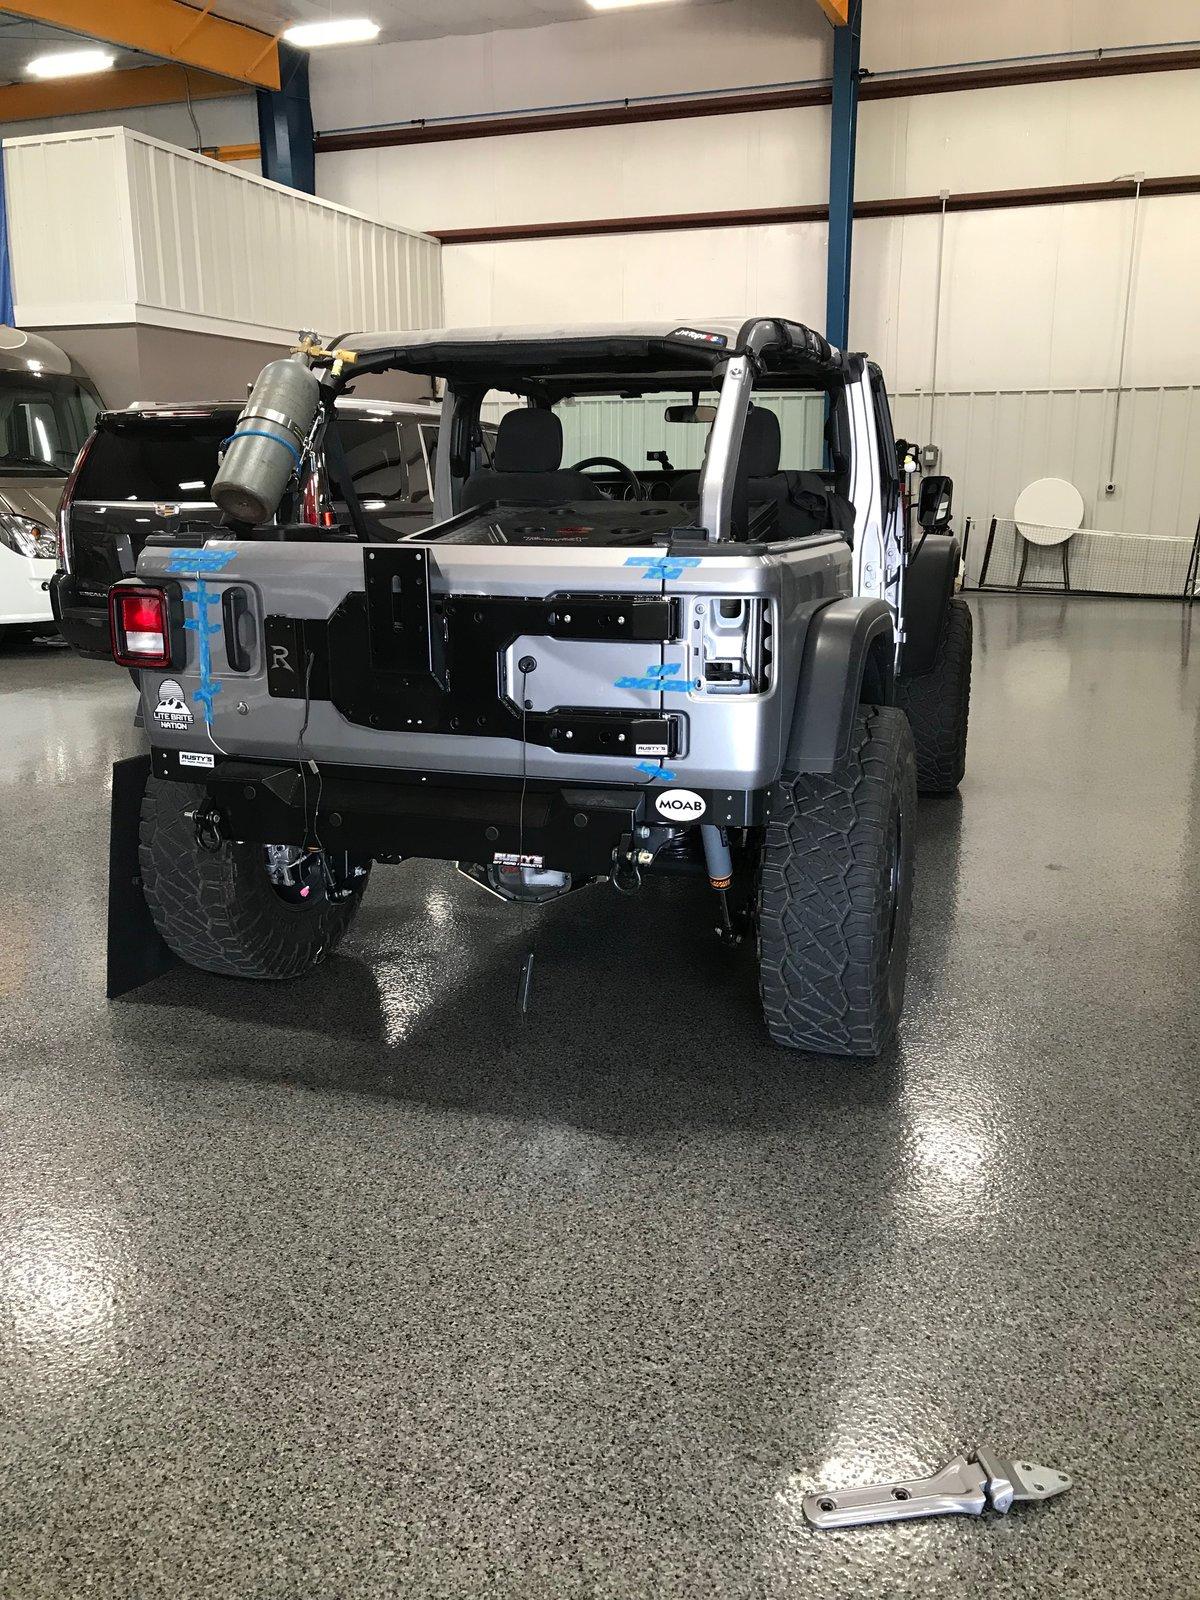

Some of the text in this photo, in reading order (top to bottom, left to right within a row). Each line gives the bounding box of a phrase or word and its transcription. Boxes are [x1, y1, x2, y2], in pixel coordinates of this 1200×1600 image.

[270, 645, 294, 672] R
[153, 711, 194, 722] LITE BRITE
[160, 721, 188, 730] NATION
[181, 754, 213, 762] RUSTY'S
[659, 800, 702, 811] MOAB
[494, 852, 543, 864] RUSTY'S
